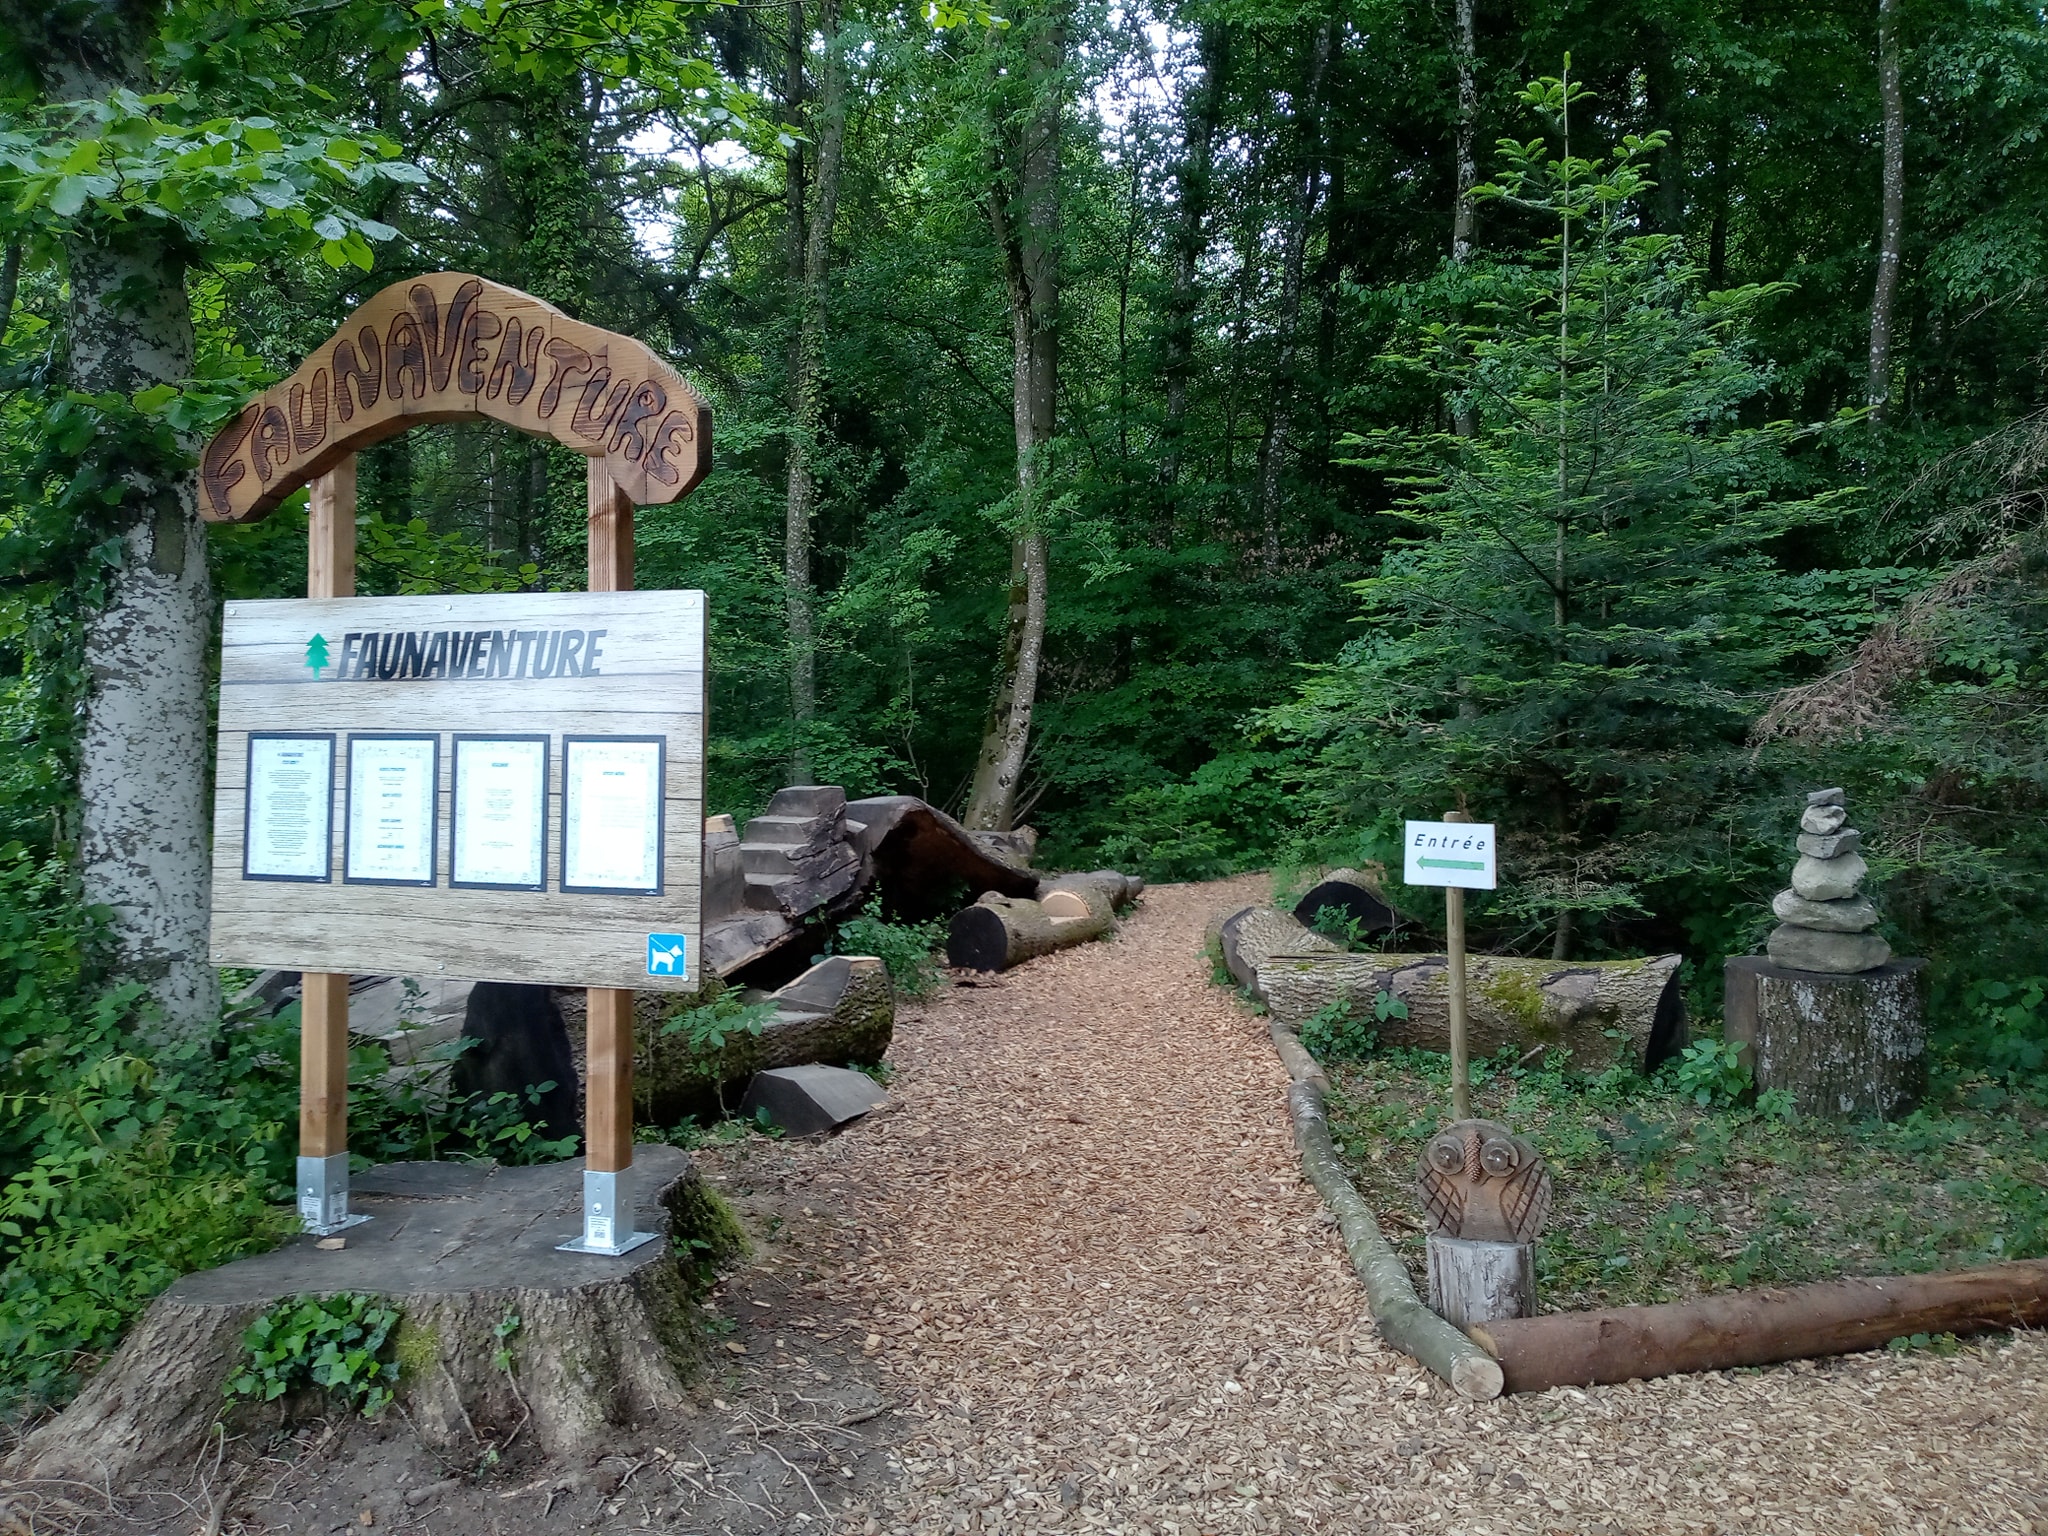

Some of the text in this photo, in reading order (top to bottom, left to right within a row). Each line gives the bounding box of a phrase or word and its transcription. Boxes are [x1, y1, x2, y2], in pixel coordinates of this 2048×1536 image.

[203, 279, 695, 514] FAUNAVENTURE
[337, 629, 608, 680] FAUNAVENTURE
[1414, 833, 1486, 851] Entrée
